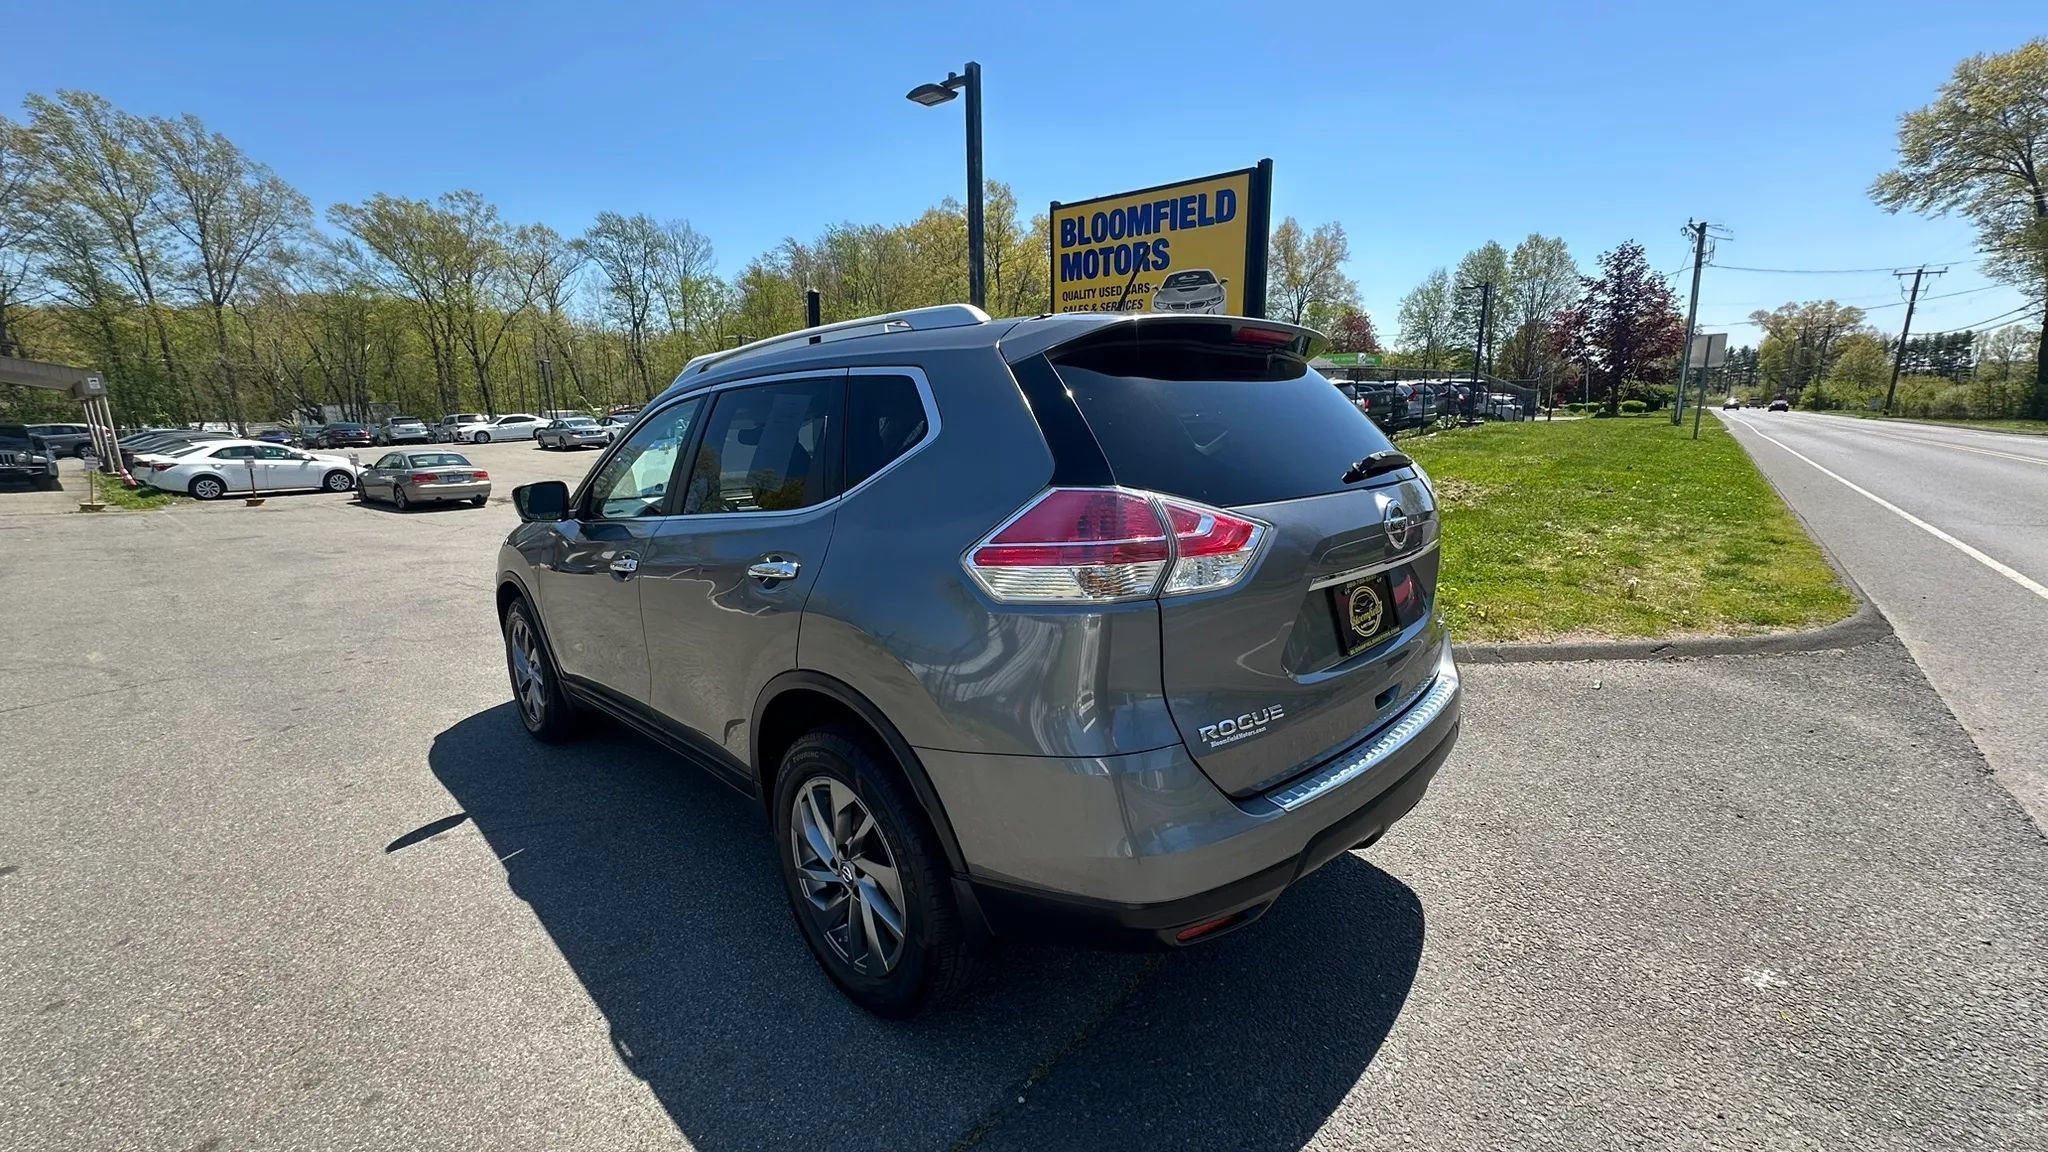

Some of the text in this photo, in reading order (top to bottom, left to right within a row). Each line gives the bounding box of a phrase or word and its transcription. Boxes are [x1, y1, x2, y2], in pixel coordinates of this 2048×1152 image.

[1060, 189, 1236, 248] BLOOMFIELD
[1060, 238, 1170, 282] MOTORS
[1062, 288, 1097, 301] QUALITY
[1098, 285, 1122, 298] USED
[1198, 703, 1285, 743] ROGUE
[792, 751, 819, 763] TOURING
